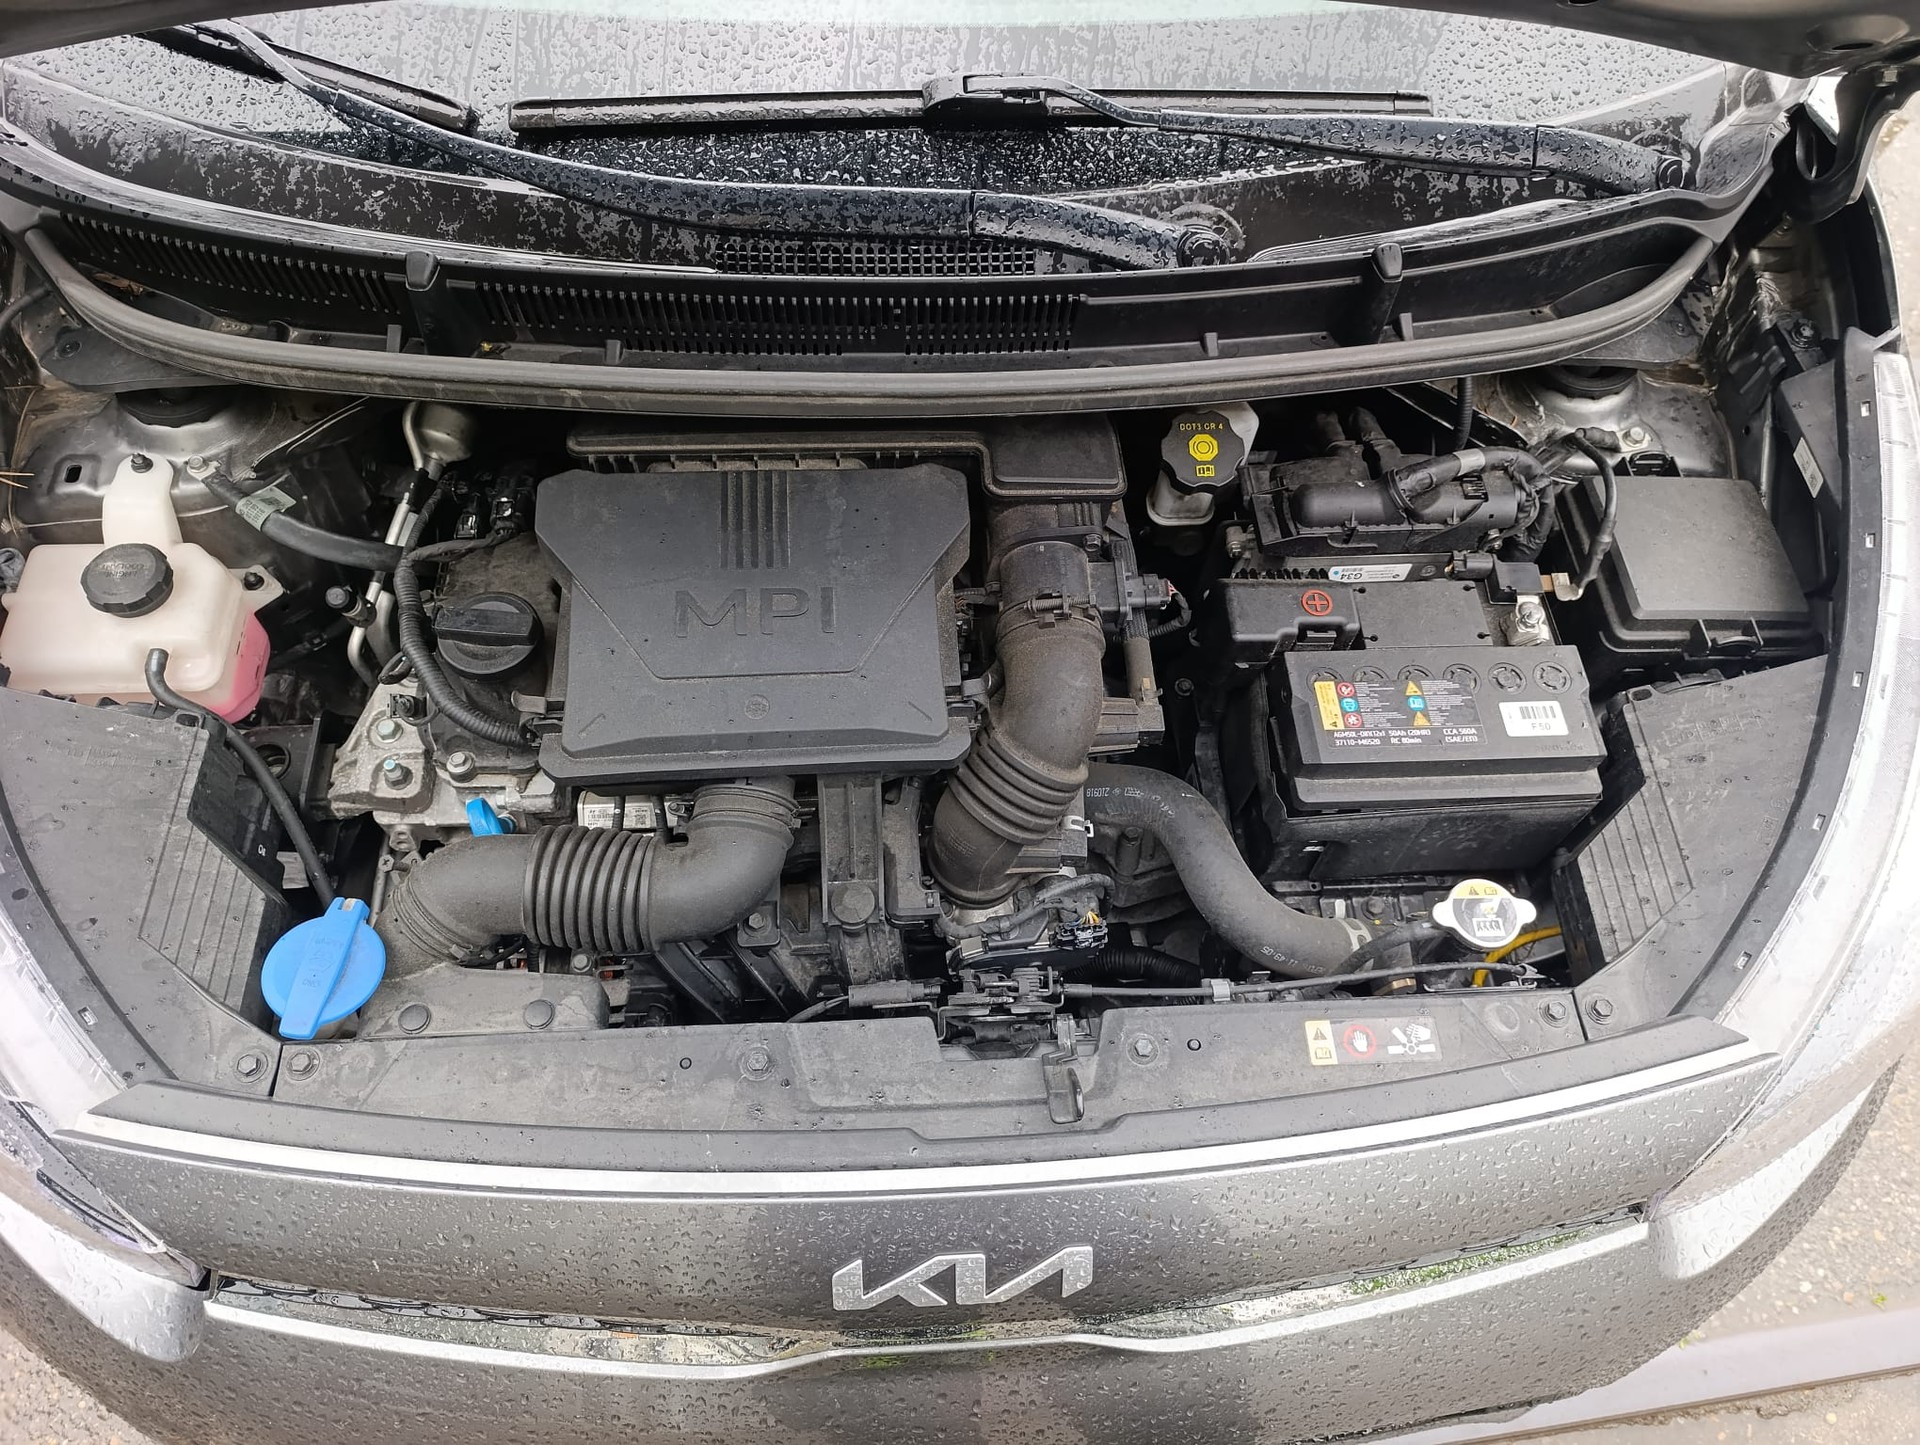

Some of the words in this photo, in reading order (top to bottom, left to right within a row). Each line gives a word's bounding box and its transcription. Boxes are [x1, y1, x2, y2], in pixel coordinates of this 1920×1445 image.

[1218, 422, 1223, 430] 4
[1340, 572, 1363, 581] G34
[675, 586, 836, 639] MPI
[1459, 727, 1477, 735] 560A
[832, 1245, 1094, 1311] KIA
